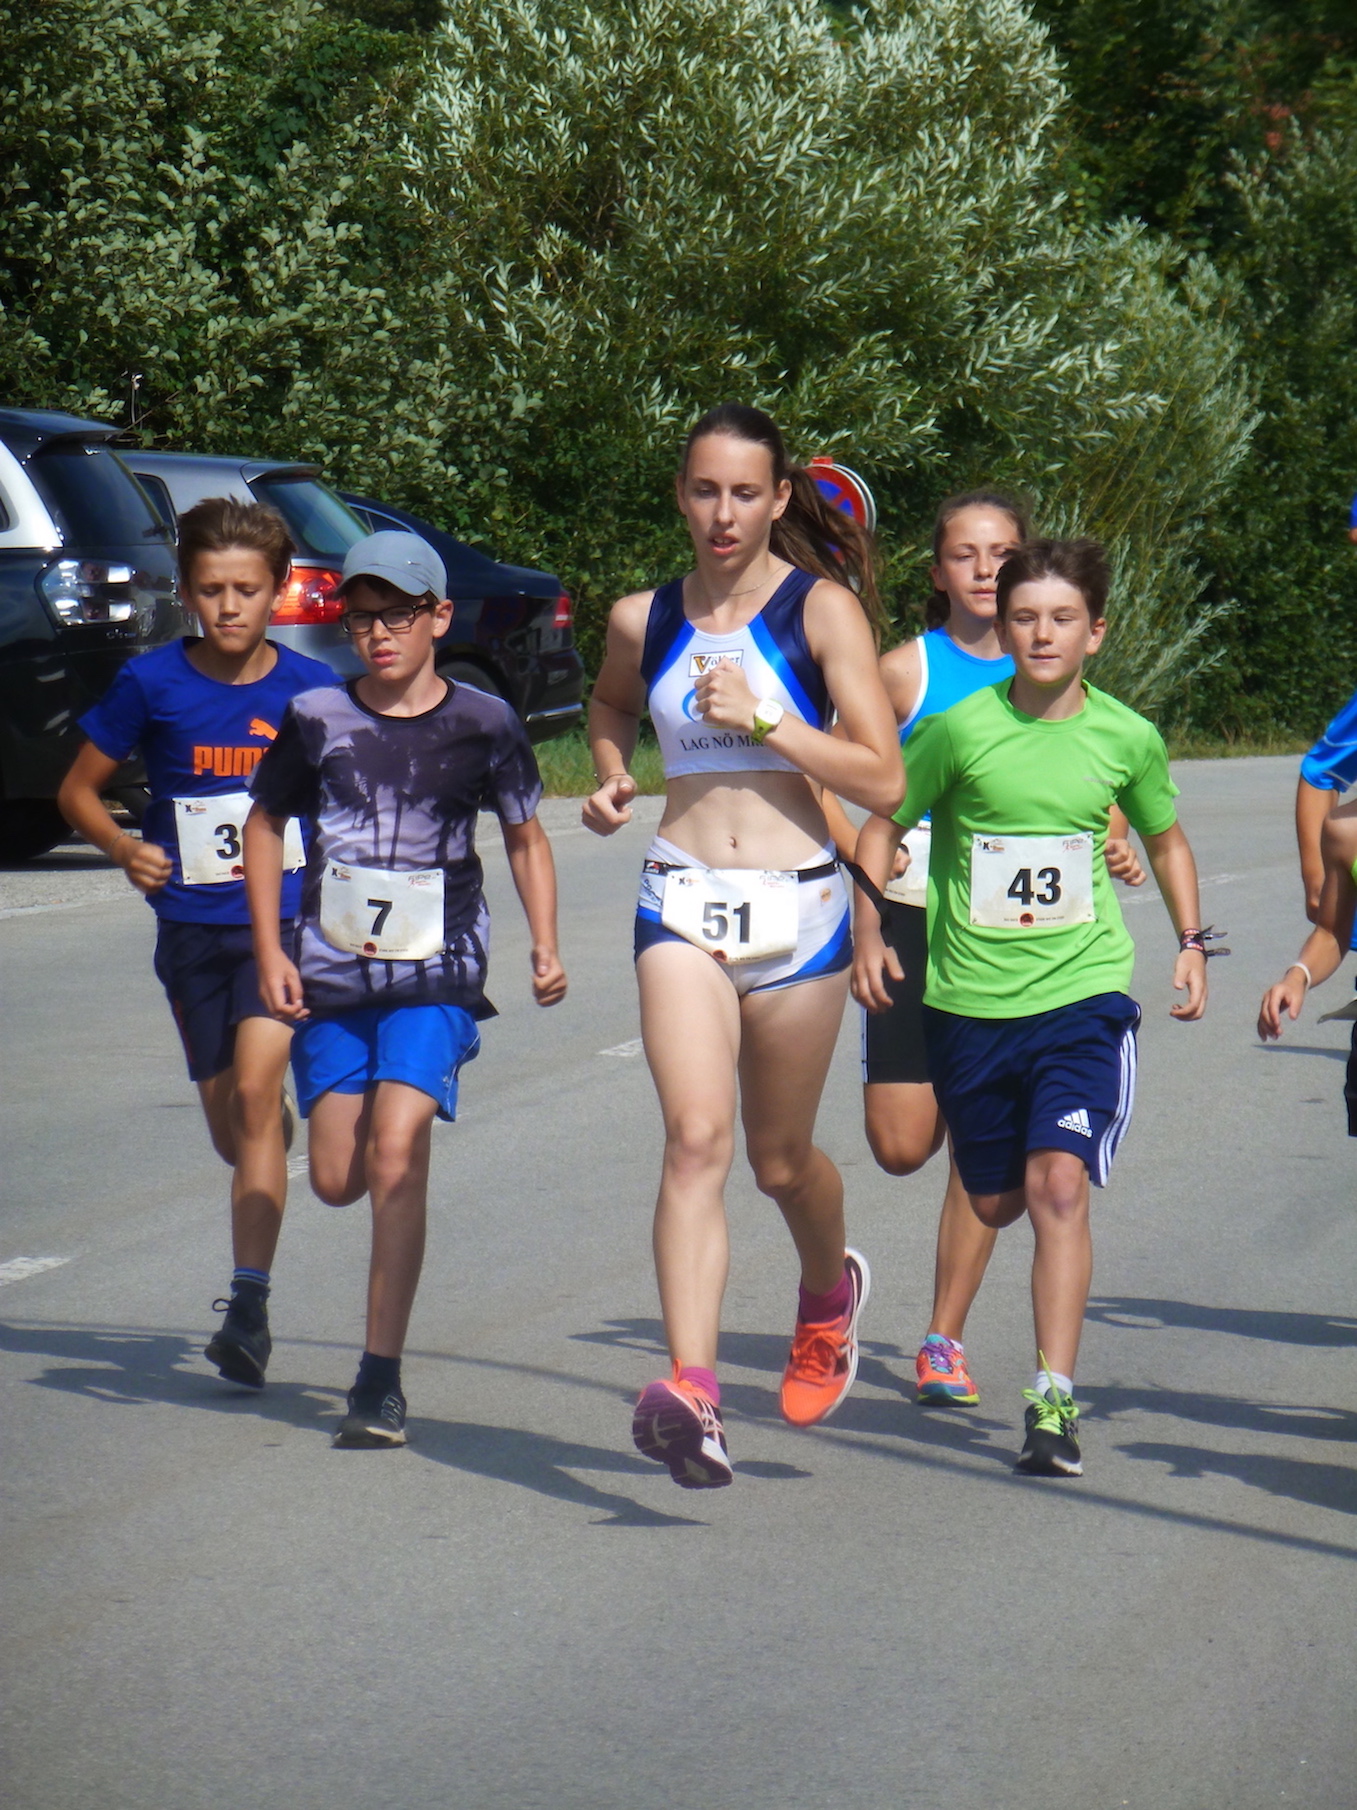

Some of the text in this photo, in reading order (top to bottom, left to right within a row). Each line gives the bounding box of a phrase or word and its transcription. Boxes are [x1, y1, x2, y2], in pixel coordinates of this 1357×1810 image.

[693, 655, 740, 674] Völr
[193, 745, 269, 776] PUM
[680, 737, 709, 751] LAG
[712, 733, 734, 749] NÖ
[214, 823, 241, 860] 3
[1007, 867, 1062, 906] 43
[367, 898, 393, 936] 7
[701, 901, 751, 944] 51
